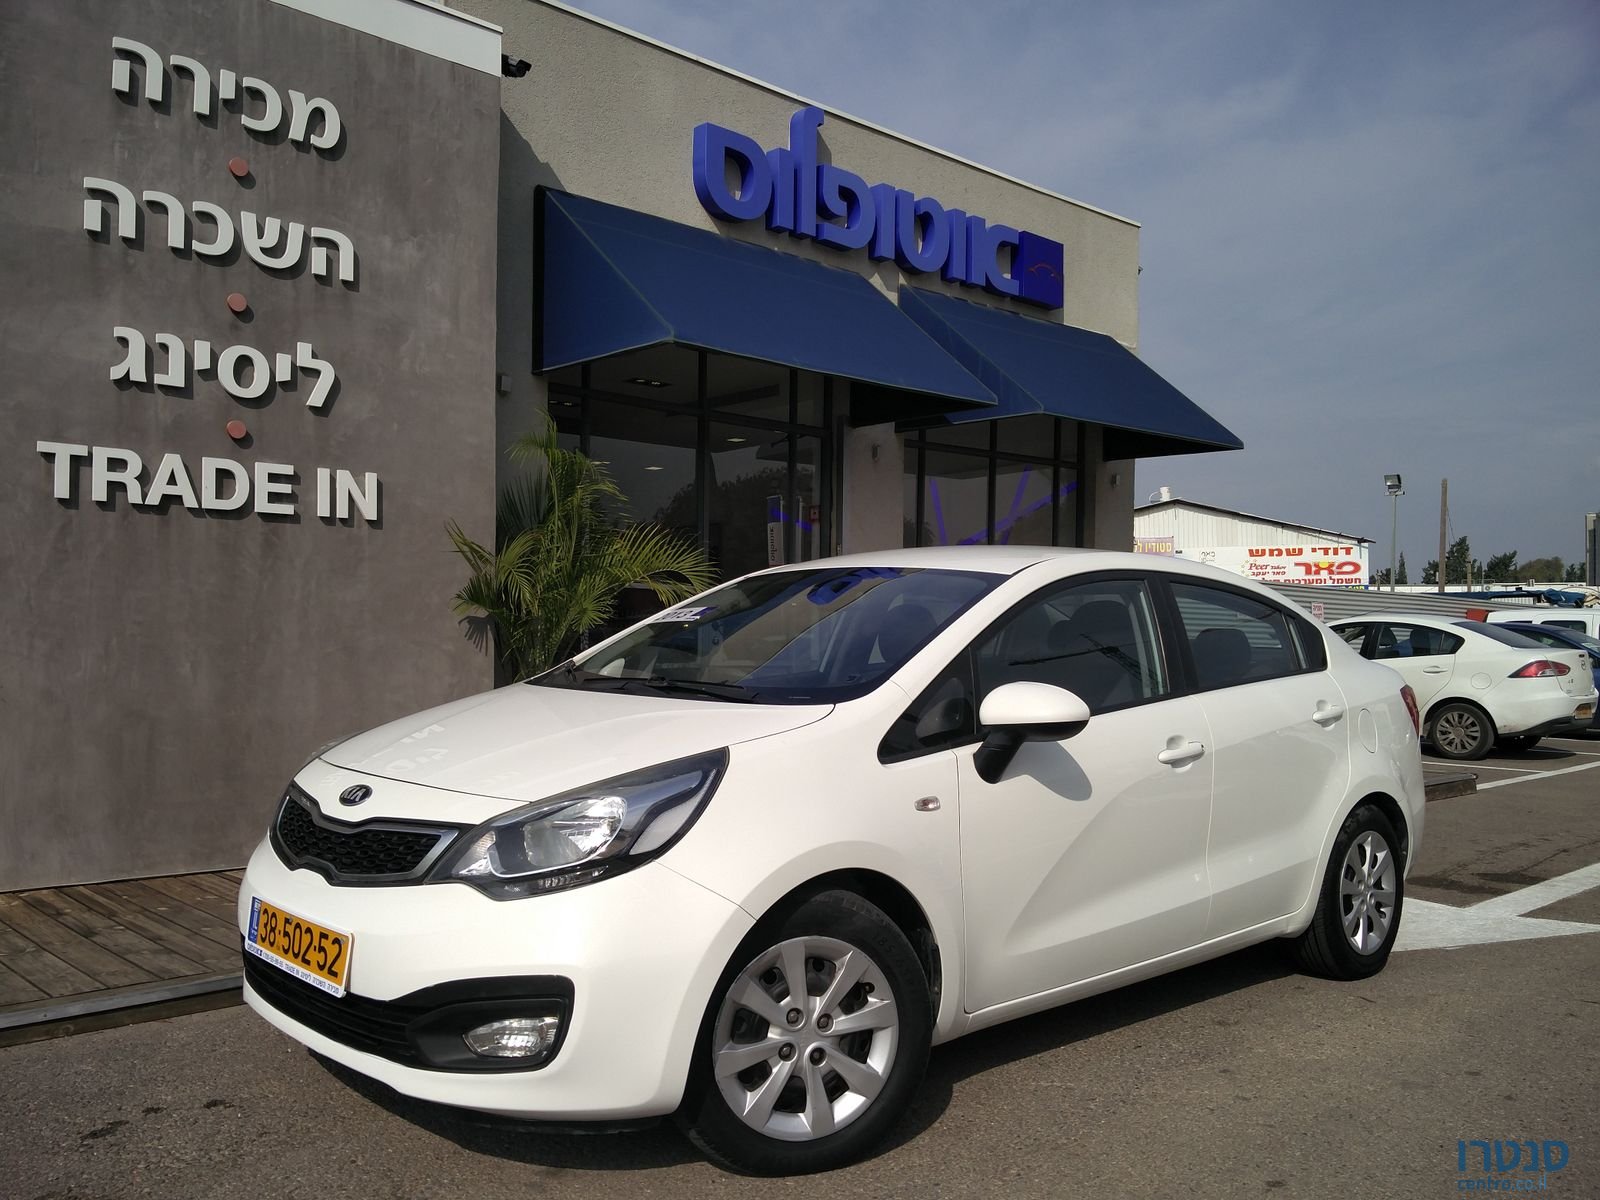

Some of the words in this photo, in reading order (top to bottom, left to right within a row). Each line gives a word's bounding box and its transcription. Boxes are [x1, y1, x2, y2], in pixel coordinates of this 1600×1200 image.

[112, 36, 341, 150] מכירה
[693, 106, 1019, 297] אוטופלוס
[83, 176, 355, 282] השכרה
[110, 326, 336, 408] ליסינג
[36, 440, 295, 516] TRADE
[317, 467, 378, 521] IN
[1248, 548, 1303, 557] שמש
[1248, 563, 1270, 571] Peer
[1294, 561, 1362, 576] פאר
[1311, 547, 1353, 556] דודי
[1329, 576, 1362, 585] חשמל
